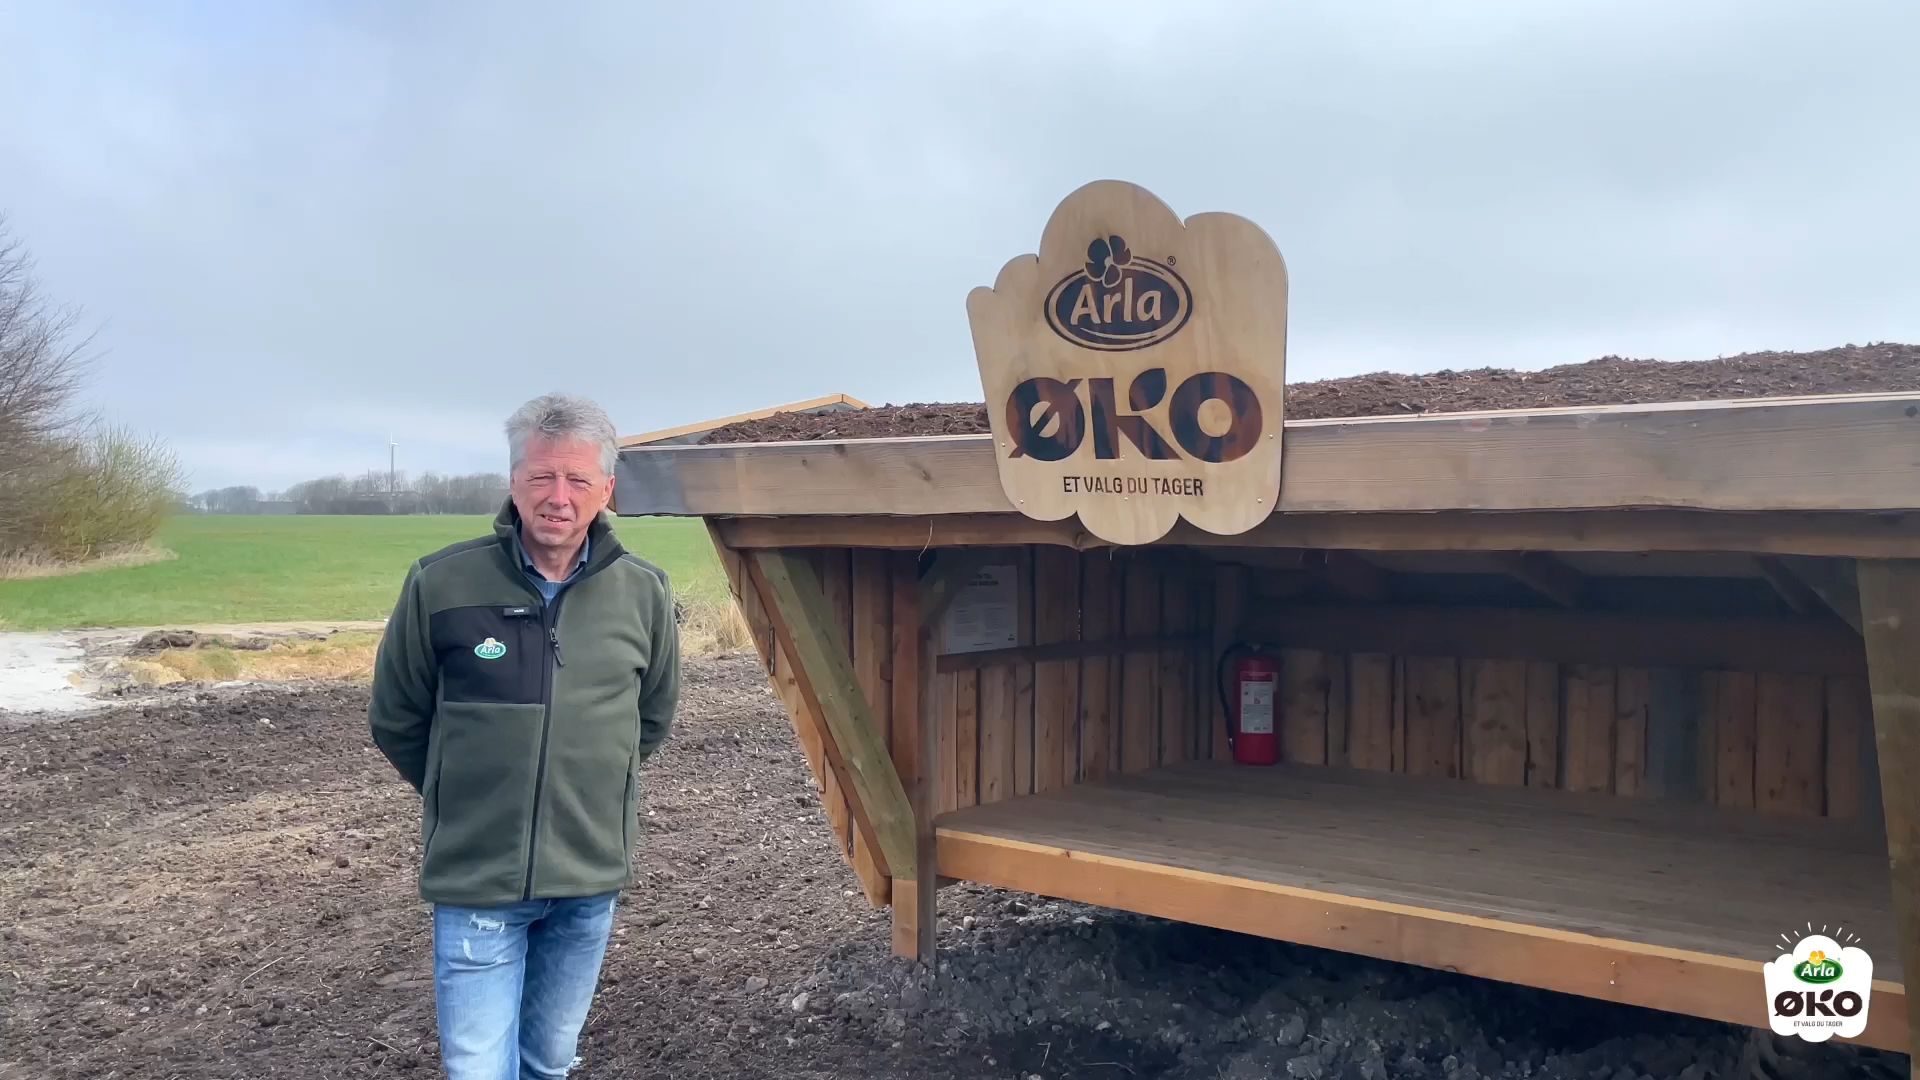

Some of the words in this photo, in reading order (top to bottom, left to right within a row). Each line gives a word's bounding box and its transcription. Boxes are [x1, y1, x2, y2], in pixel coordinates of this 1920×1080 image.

[1070, 278, 1162, 326] Arla
[1005, 367, 1264, 464] ØKO
[1062, 476, 1081, 493] ET
[1083, 476, 1123, 494] VALG
[1127, 477, 1148, 494] DU
[1151, 478, 1204, 496] TAGER
[480, 645, 501, 654] Arla
